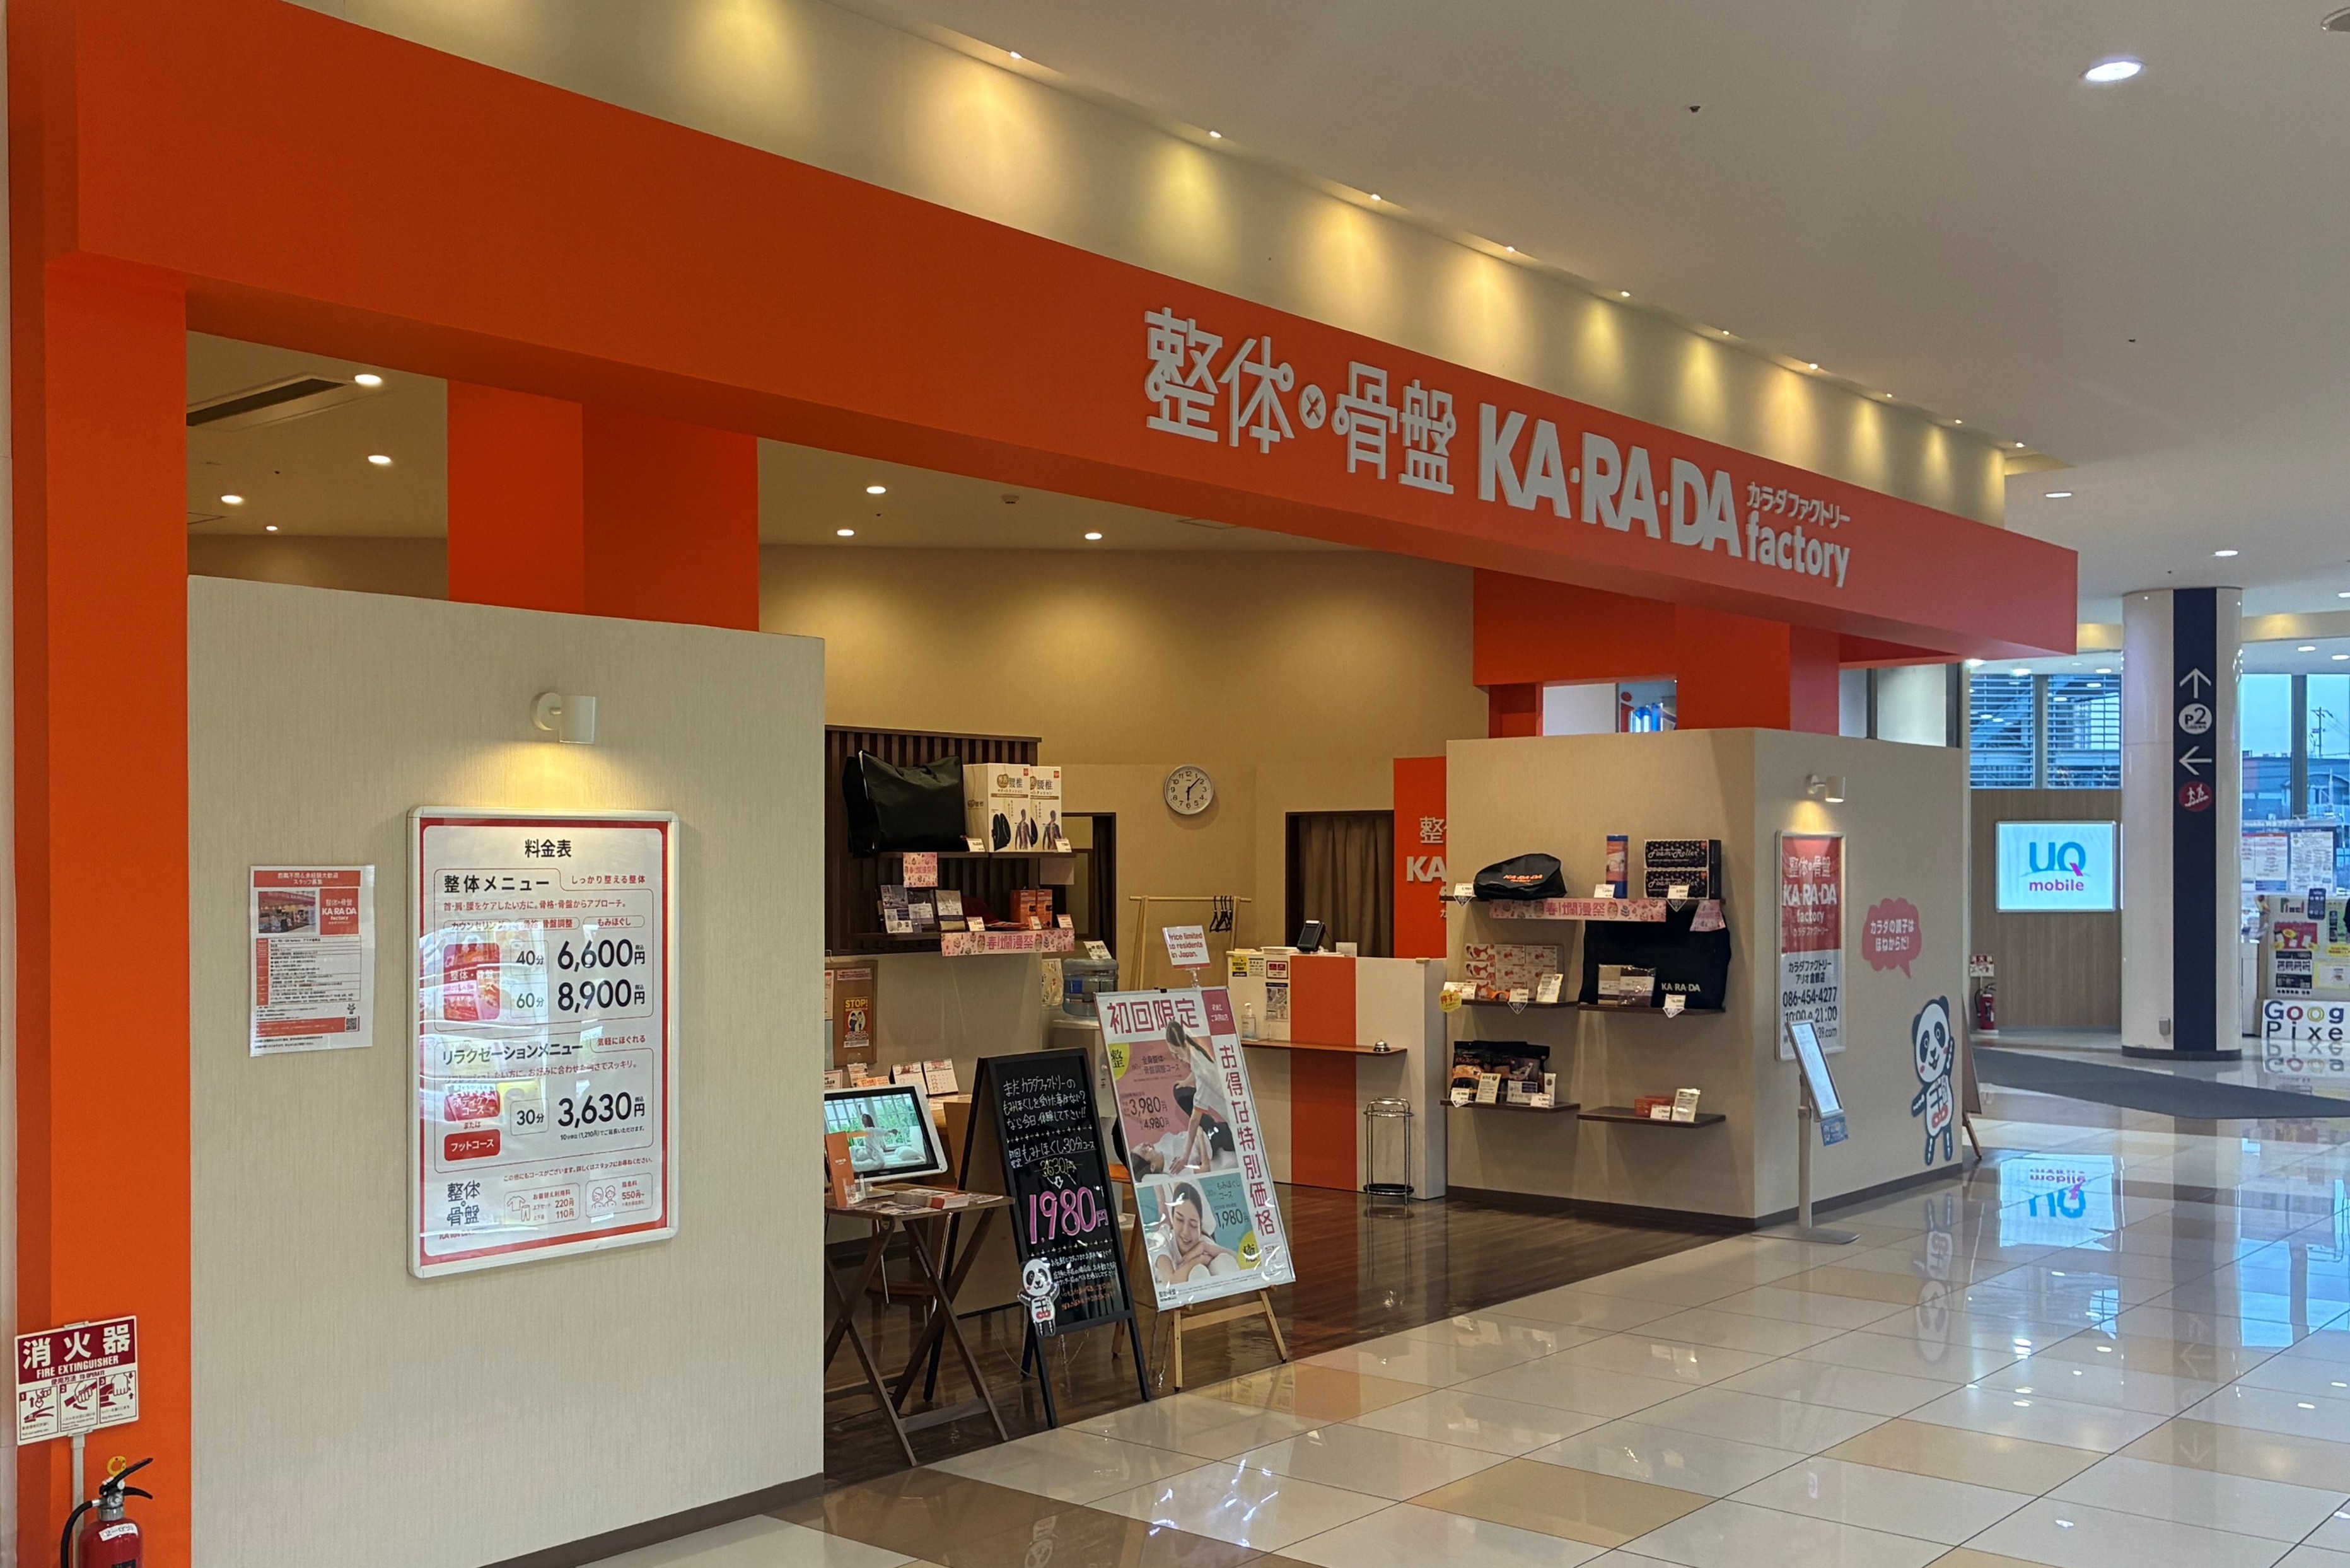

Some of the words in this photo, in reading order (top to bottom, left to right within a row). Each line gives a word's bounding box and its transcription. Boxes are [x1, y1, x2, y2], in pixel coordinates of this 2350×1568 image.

[1746, 482, 1851, 528] カラダファクトリー
[1746, 510, 1850, 588] factory
[2185, 707, 2206, 724] P2
[1419, 816, 1446, 844] 整
[525, 839, 572, 858] 料金表
[2029, 842, 2086, 876] UQ
[444, 875, 550, 894] 整体メニュー
[571, 875, 646, 885] しっかり整える整体
[2029, 879, 2084, 891] mobile
[597, 917, 631, 927] もみほぐし
[1797, 909, 1824, 923] factory
[1870, 919, 1914, 934] カラダの調子は
[516, 950, 544, 965] 40分
[1789, 960, 1832, 973] カラダファクトリー
[516, 992, 544, 1008] 60分
[845, 999, 868, 1008] STOP!
[1783, 987, 1837, 1007] 086-454-4277
[1107, 998, 1199, 1034] 初回限定
[1815, 1006, 1837, 1023] 21:00
[443, 1043, 583, 1066] リラクゼーションメニュー
[597, 1035, 646, 1046] 気軽にほぐれる
[462, 1106, 484, 1115] コース
[516, 1109, 544, 1125] 30分
[451, 1139, 494, 1152] フットコース
[1219, 1045, 1275, 1236] お得な特別価格
[1219, 1191, 1233, 1200] コース
[23, 1324, 130, 1369] 消火器
[37, 1368, 55, 1379] FIRE
[58, 1355, 119, 1374] EXTINGUISHER
[52, 1376, 76, 1385] 使用方法
[86, 1370, 105, 1379] OPERATE
